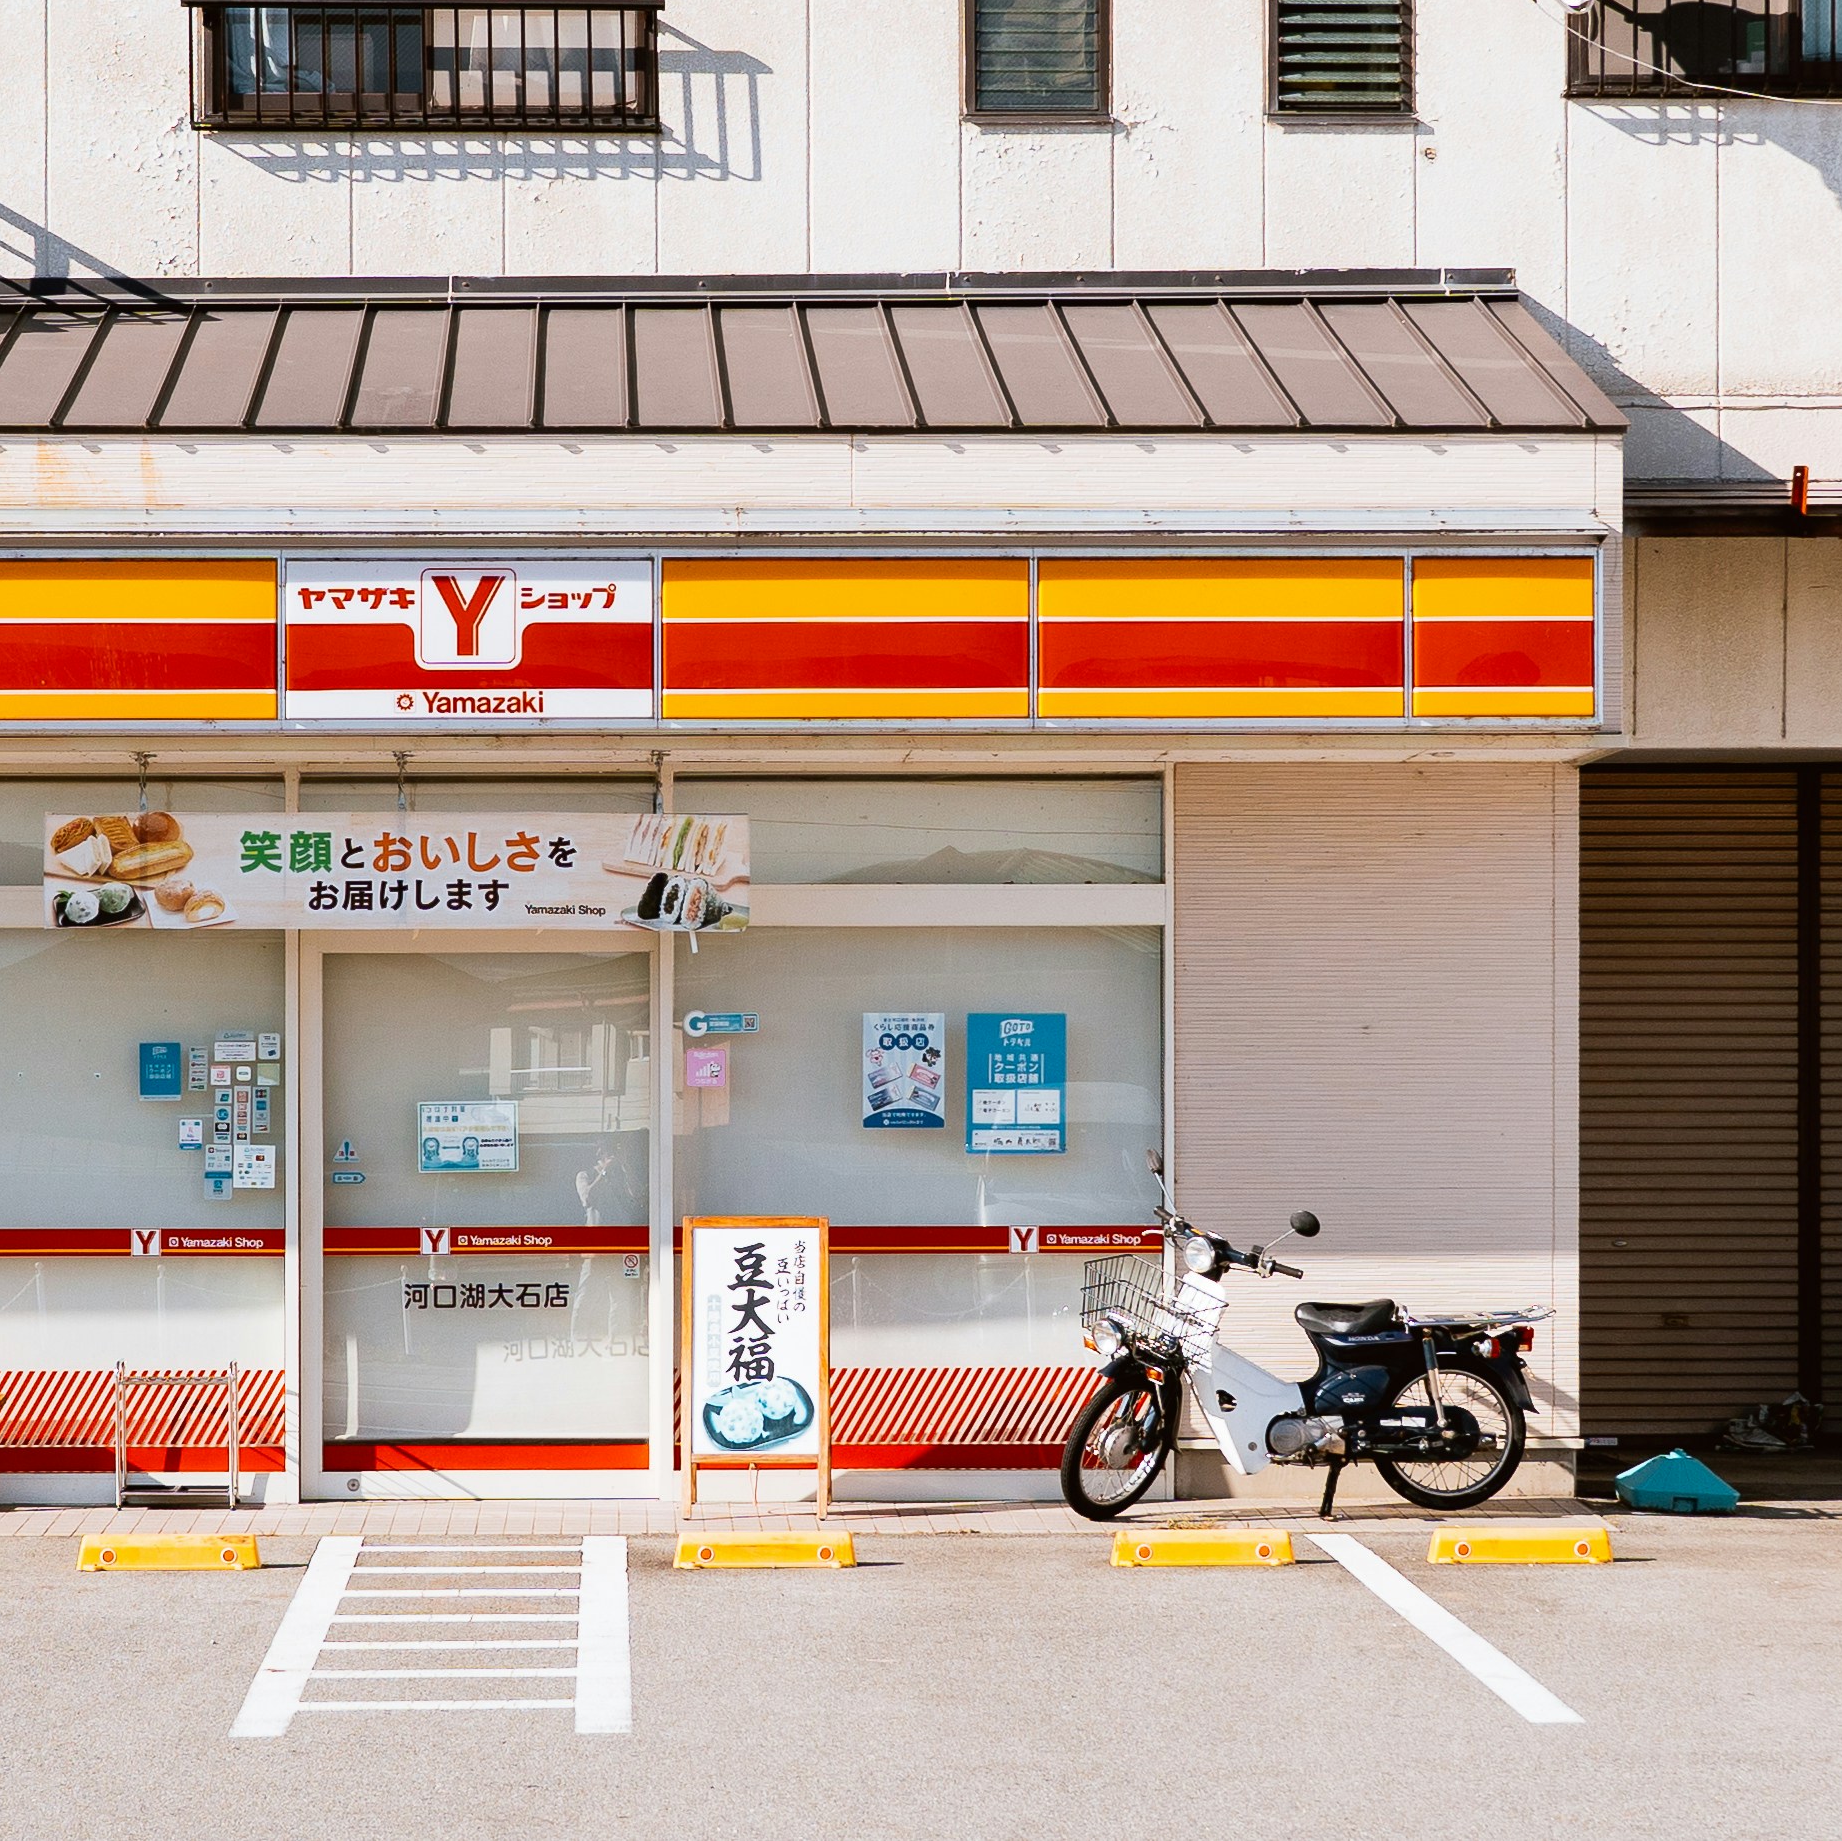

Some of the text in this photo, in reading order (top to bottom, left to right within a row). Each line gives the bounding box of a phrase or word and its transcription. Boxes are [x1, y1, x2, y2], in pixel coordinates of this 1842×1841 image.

[298, 575, 617, 656] ヤマザキ Y ショップ
[423, 691, 544, 714] Yamazaki
[239, 830, 577, 874] 笑顔とおいしさを
[309, 879, 510, 912] お届けします
[524, 904, 606, 917] Yamazaki Shop
[1003, 1038, 1031, 1047] トラベル
[994, 1063, 1039, 1072] クーポン
[135, 1230, 264, 1255] Y Yamazaki Shop
[424, 1229, 553, 1253] Y Yamazaki Shop
[1013, 1227, 1142, 1251] Y Yamazaki Shop
[793, 1240, 806, 1312] 当店自慢の
[404, 1282, 570, 1309] 河口湖大石店
[726, 1242, 775, 1383] 豆大福
